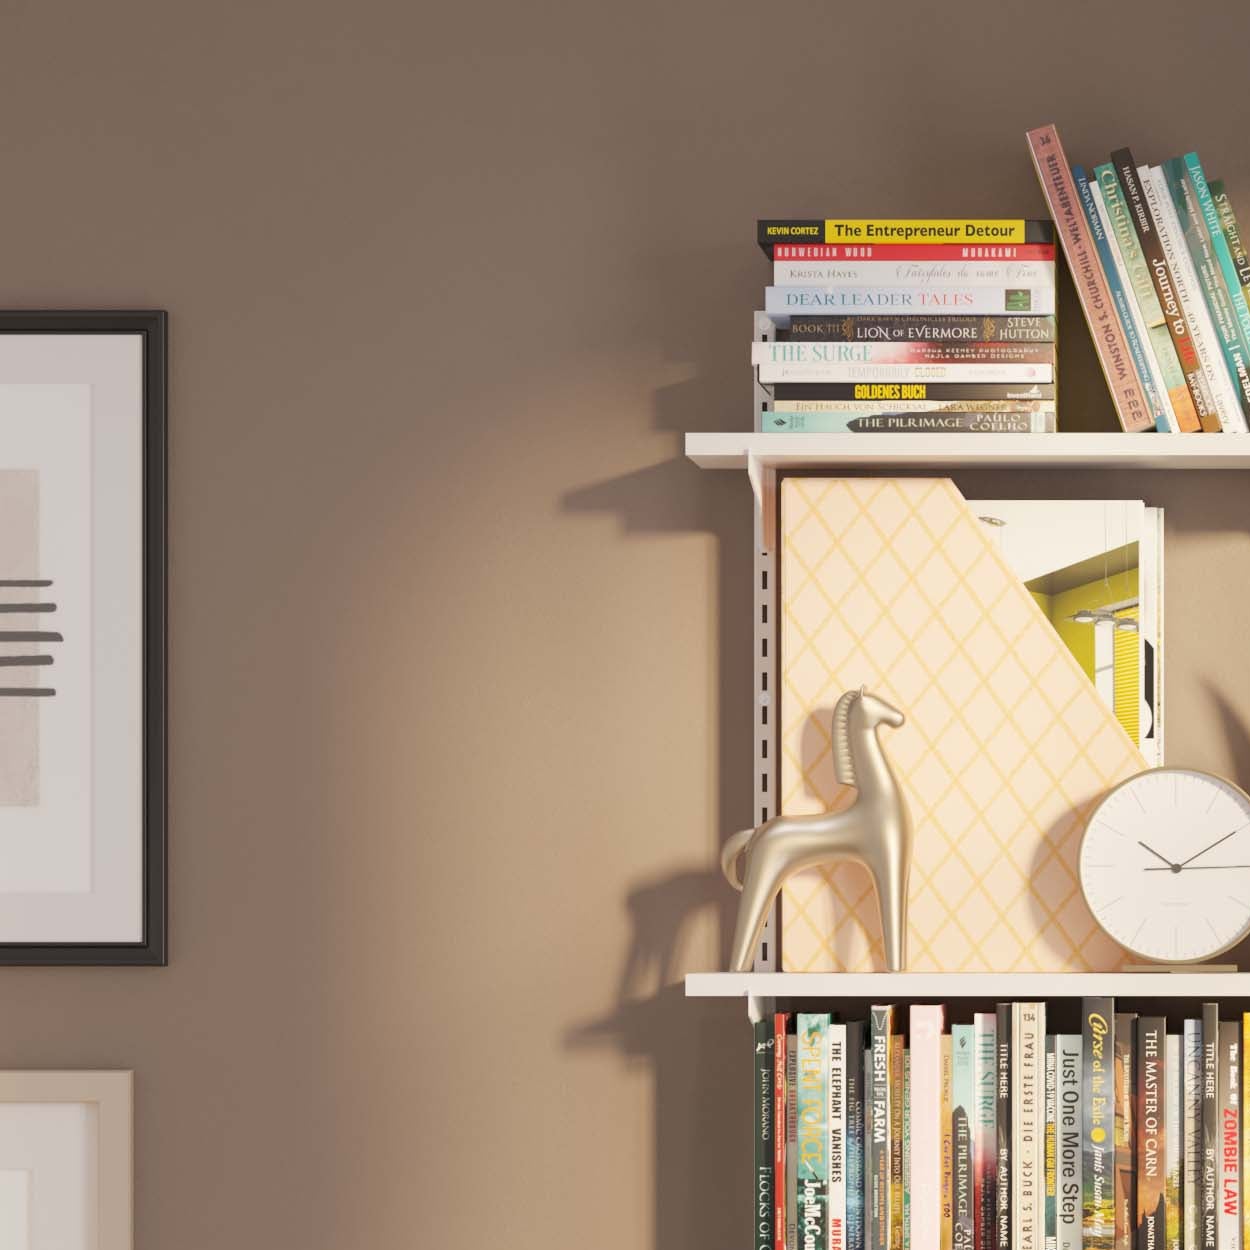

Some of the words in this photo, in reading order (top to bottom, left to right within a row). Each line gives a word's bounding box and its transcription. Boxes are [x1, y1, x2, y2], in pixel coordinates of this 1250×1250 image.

[1189, 165, 1210, 200] JASON
[1200, 198, 1223, 238] WHITE
[767, 226, 790, 235] KEVIN
[791, 226, 819, 235] CORTEZ
[835, 224, 861, 236] The
[866, 224, 960, 240] Entrepreneur
[965, 224, 1015, 237] Detour
[845, 247, 872, 257] WOOD
[962, 247, 1017, 257] MURAKAMI
[786, 294, 834, 305] DEAR
[841, 294, 912, 305] LEADER
[919, 294, 974, 305] TALES
[857, 326, 891, 340] LION
[892, 330, 904, 338] OF
[908, 325, 978, 339] EVERMORE
[1000, 329, 1050, 341] HUTTON
[1007, 317, 1041, 328] STEVE
[768, 345, 808, 362] THE
[812, 345, 873, 362] SURGE
[854, 384, 901, 400] GOLDENES
[901, 384, 926, 400] BUCH
[857, 417, 885, 428] THE
[888, 417, 963, 428] PILRIMAGE
[969, 422, 1028, 431] COELHO
[976, 413, 1021, 422] PAULO
[1022, 1032, 1034, 1068] FRAU
[1089, 1012, 1109, 1060] Curse
[1145, 1030, 1158, 1058] THE
[831, 1041, 842, 1062] THE
[874, 1035, 886, 1072] FRESH
[1000, 1043, 1009, 1070] TITLE
[1206, 1042, 1215, 1070] TITLE
[1059, 1049, 1080, 1086] Just
[759, 1068, 771, 1096] JOHN
[831, 1067, 842, 1120] ELEPHANT
[1000, 1072, 1009, 1099] HERE
[1022, 1075, 1034, 1113] ERSTE
[1145, 1060, 1158, 1115] MASTER
[1206, 1071, 1215, 1099] HERE
[759, 1097, 771, 1141] MORANO
[874, 1100, 886, 1144] FARM
[1059, 1090, 1080, 1127] One
[958, 1117, 968, 1141] THE
[1022, 1121, 1034, 1143] DIE
[1145, 1116, 1158, 1136] OF
[1000, 1148, 1009, 1161] BY
[1059, 1131, 1080, 1178] More
[1206, 1148, 1215, 1161] BY
[1223, 1108, 1238, 1174] ZOMBIE
[831, 1128, 842, 1183] VANISHES
[1145, 1138, 1158, 1177] CARN
[758, 1166, 773, 1218] FLOCKS
[958, 1144, 968, 1217] PILRIMAGE
[1000, 1166, 1009, 1211] AUTHOR
[1022, 1161, 1034, 1197] BUCK
[1206, 1166, 1215, 1210] AUTHOR
[1022, 1203, 1034, 1212] S.
[1059, 1182, 1080, 1225] Step
[1223, 1178, 1238, 1216] LAW
[758, 1221, 773, 1240] OF
[1000, 1214, 1009, 1248] NAME
[1206, 1214, 1215, 1248] NAME
